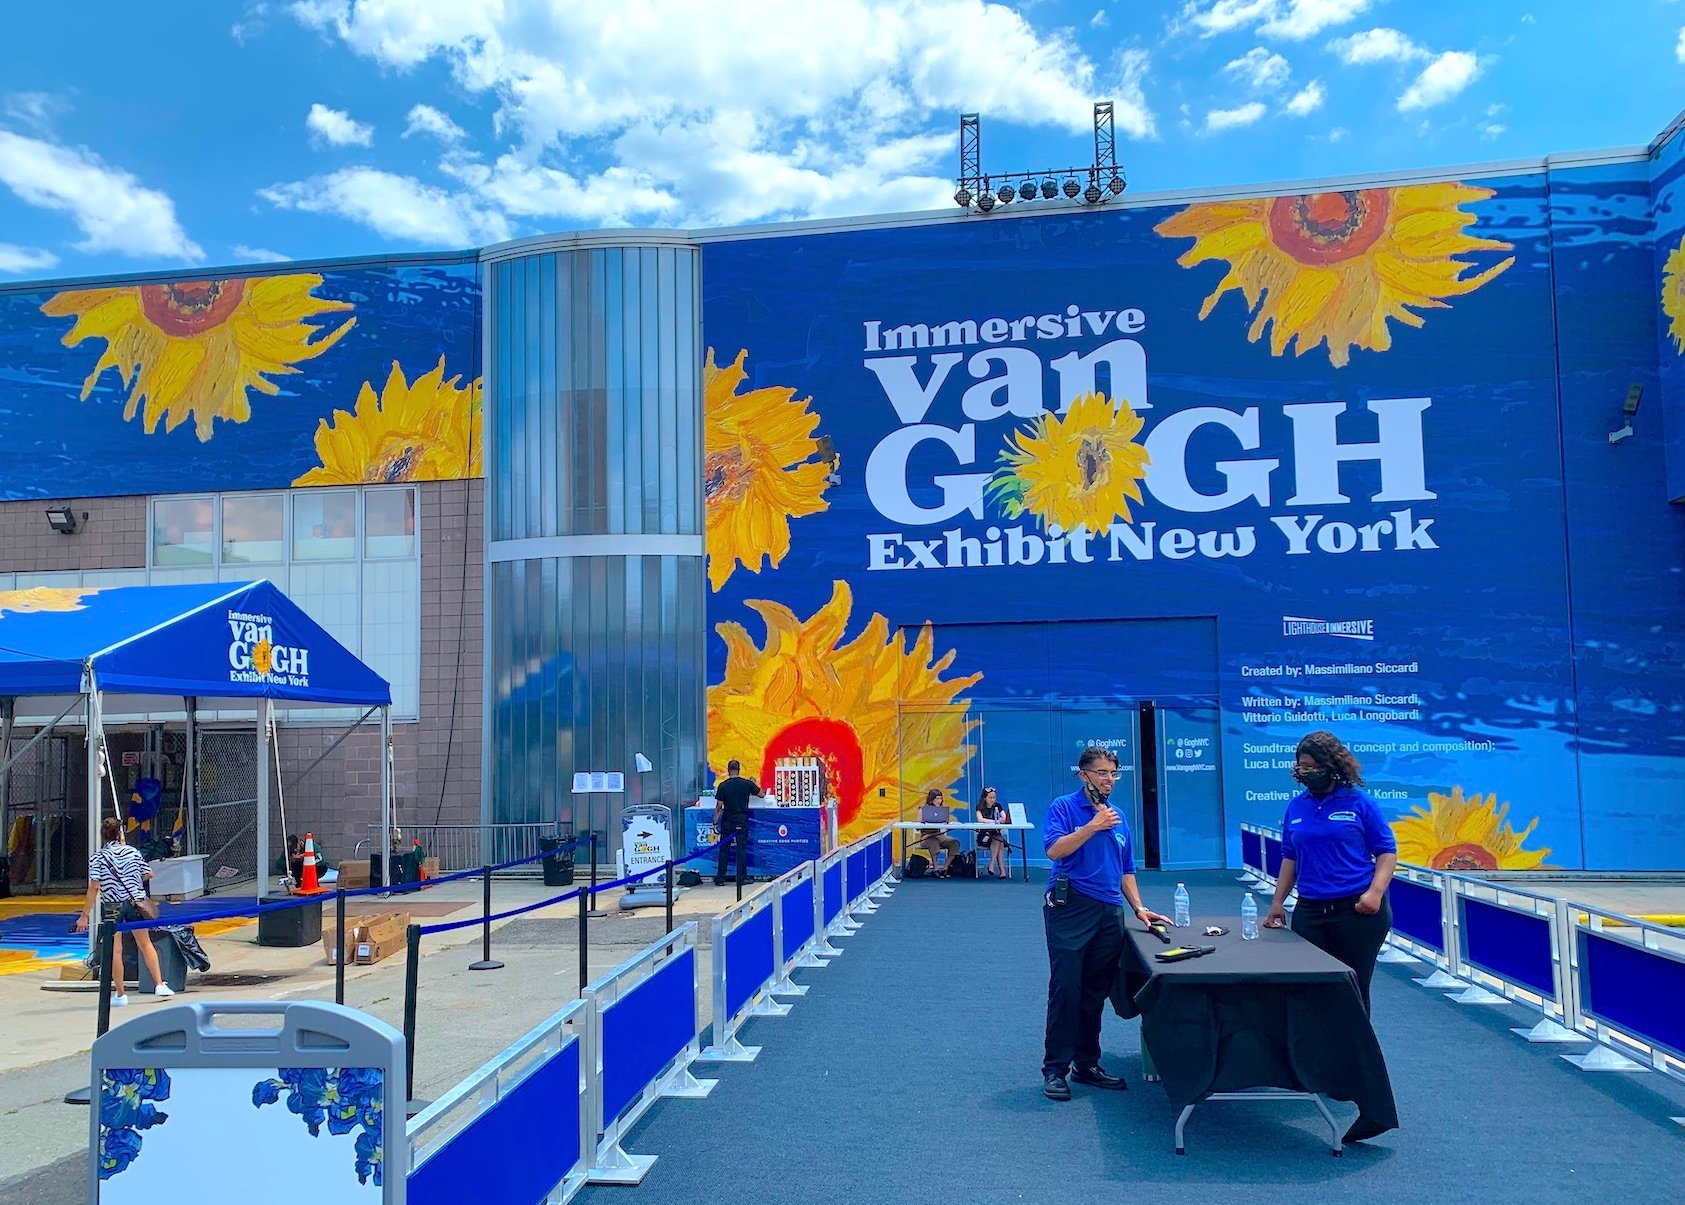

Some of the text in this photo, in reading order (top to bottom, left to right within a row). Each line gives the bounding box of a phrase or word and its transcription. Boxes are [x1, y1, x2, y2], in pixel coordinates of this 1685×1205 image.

[864, 304, 1146, 351] Immersive
[864, 338, 1154, 425] van
[865, 397, 1437, 527] GGH
[866, 508, 1440, 571] Exhibit New York
[228, 609, 272, 624] Immersive
[228, 620, 273, 645] van
[229, 640, 309, 675] GGH
[1241, 662, 1419, 678] Created by: Massimiliano Siccardi
[229, 670, 309, 688] Exhibit New York
[1241, 693, 1421, 709] Written by: Massimiliano Siccardi,
[1242, 709, 1420, 724] Vittorio Guidotti, Luca Longobardi
[1243, 742, 1299, 754] Soundtrac
[1353, 742, 1396, 754] concept
[1400, 741, 1419, 752] and
[1422, 739, 1496, 754] composition):
[1244, 759, 1270, 769] Luca
[1245, 790, 1290, 801] Creative
[1374, 788, 1408, 800] Korins
[630, 855, 666, 865] ENTRANCE
